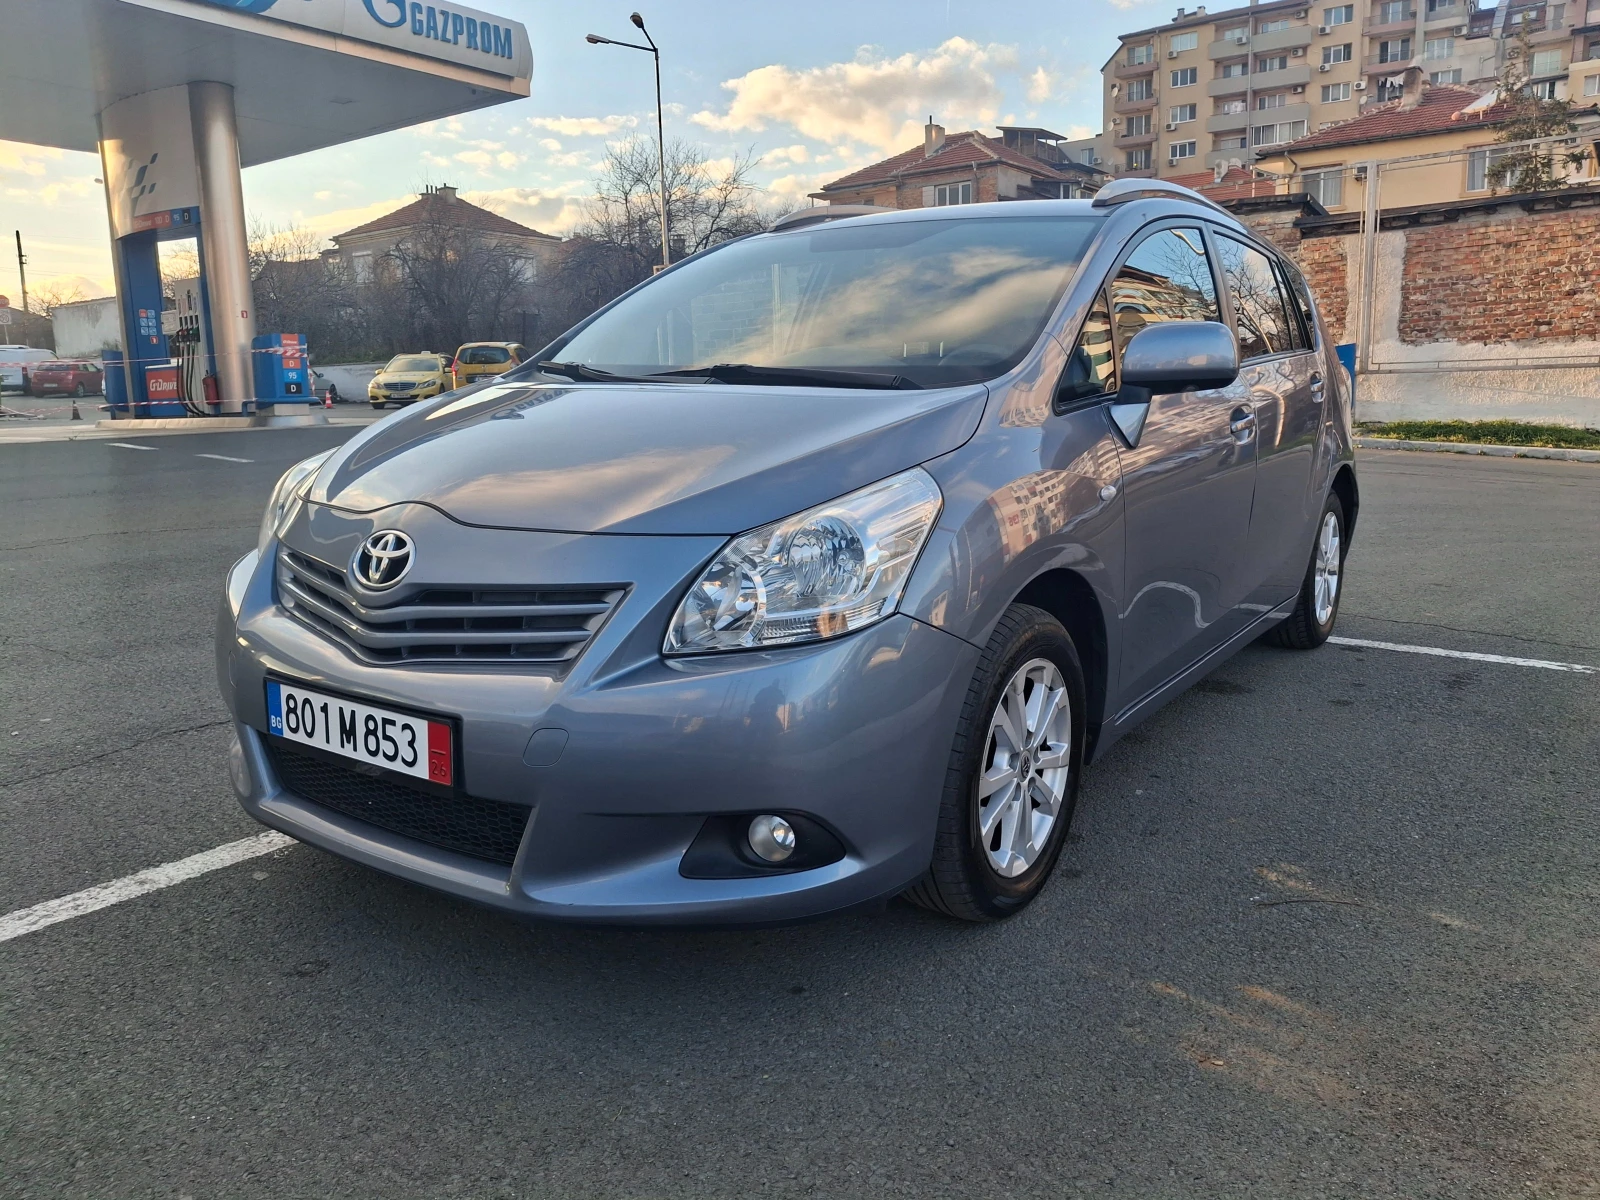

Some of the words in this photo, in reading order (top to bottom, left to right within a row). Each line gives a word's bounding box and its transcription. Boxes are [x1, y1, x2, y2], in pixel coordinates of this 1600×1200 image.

[409, 1, 513, 60] GAZPROM
[173, 213, 180, 221] 95
[288, 371, 297, 379] 95
[290, 384, 297, 392] D
[270, 714, 282, 730] BG
[431, 759, 447, 777] 26
